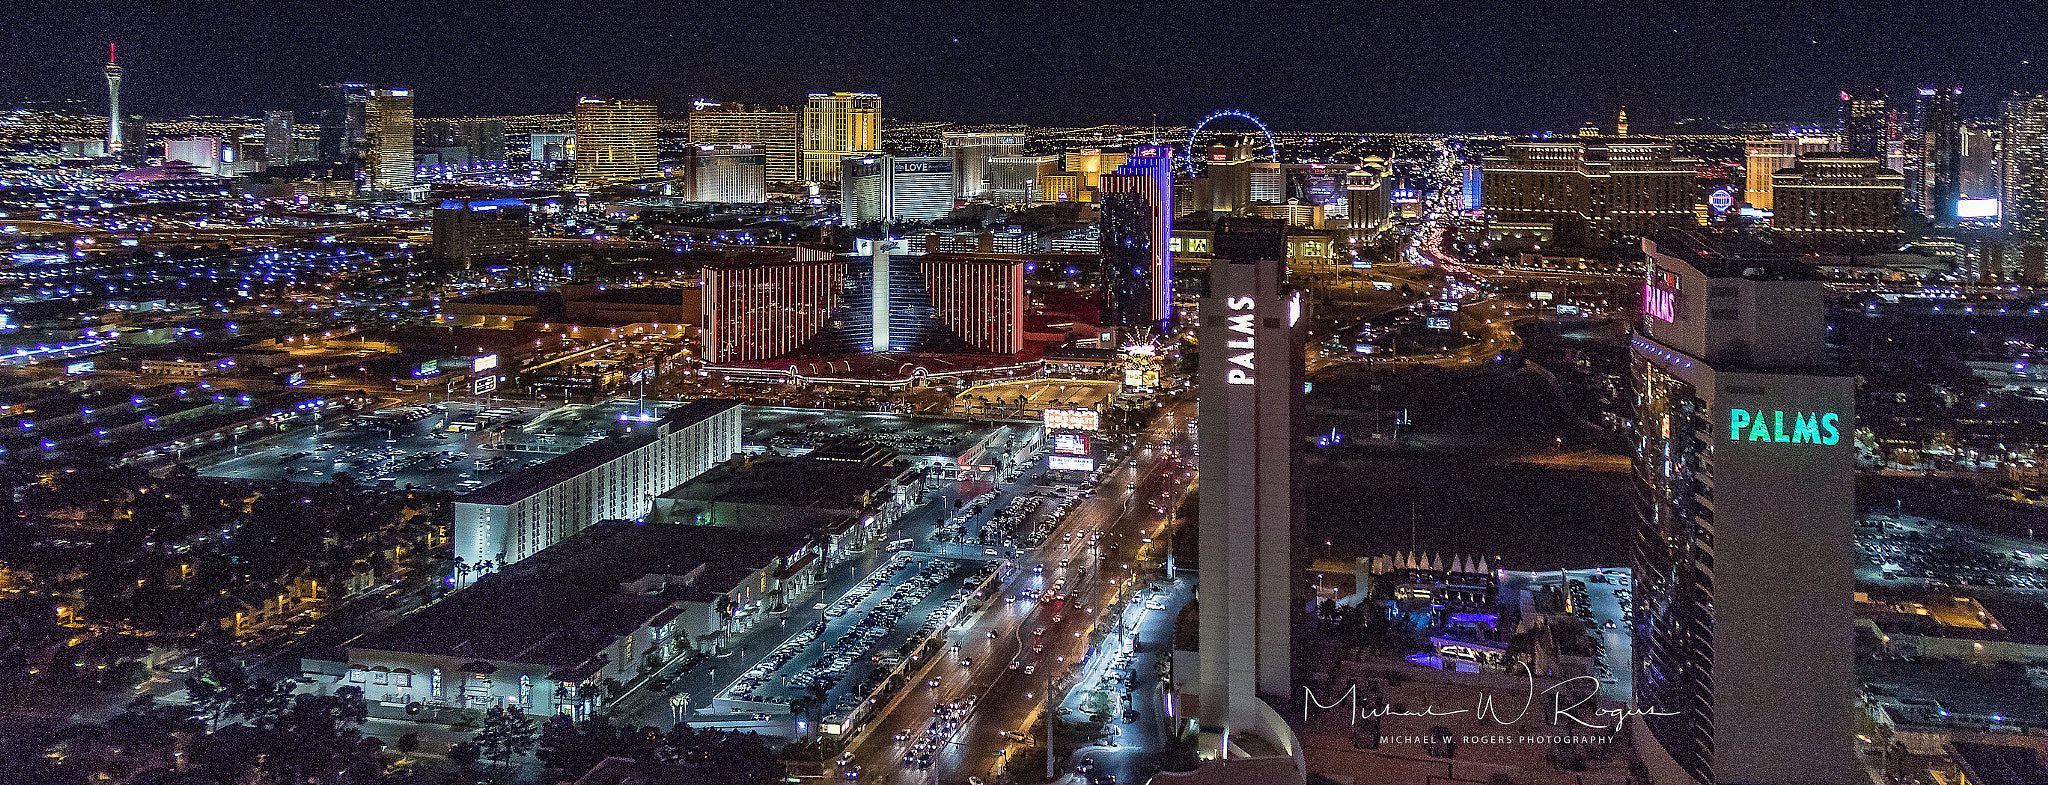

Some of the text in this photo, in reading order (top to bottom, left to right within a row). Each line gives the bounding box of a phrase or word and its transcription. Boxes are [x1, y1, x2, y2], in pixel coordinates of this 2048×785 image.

[904, 163, 928, 172] LOVE
[1645, 285, 1675, 324] PALMS
[1227, 296, 1255, 385] PALMS
[1730, 408, 1840, 446] PALMS
